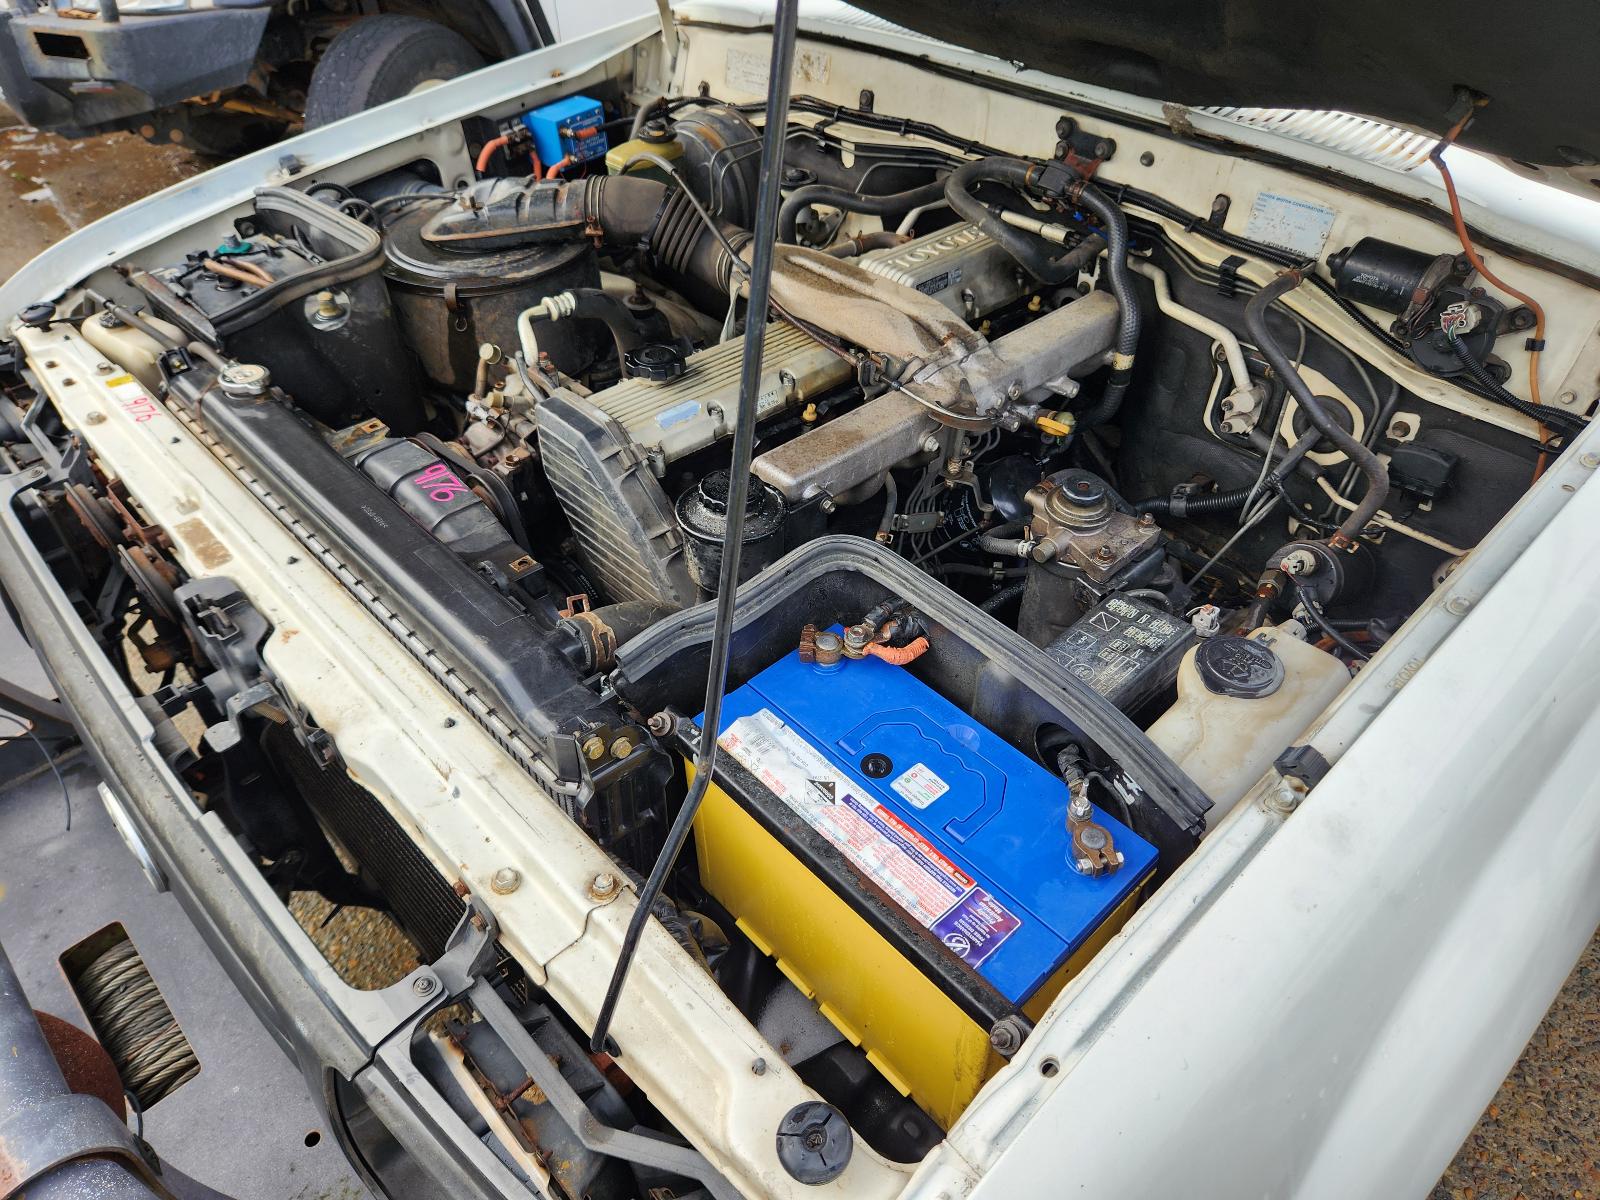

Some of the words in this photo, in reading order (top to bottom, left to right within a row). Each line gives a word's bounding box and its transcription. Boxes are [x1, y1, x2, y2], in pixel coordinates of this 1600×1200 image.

[414, 463, 468, 502] 9176
[813, 780, 833, 799] CORROSIVE
[975, 907, 996, 925] Proudly
[978, 901, 1003, 922] Australian
[987, 900, 1002, 914] Made
[952, 920, 982, 946] MAINTENANCE
[958, 918, 974, 932] DESIGN
[973, 930, 985, 941] FREE
